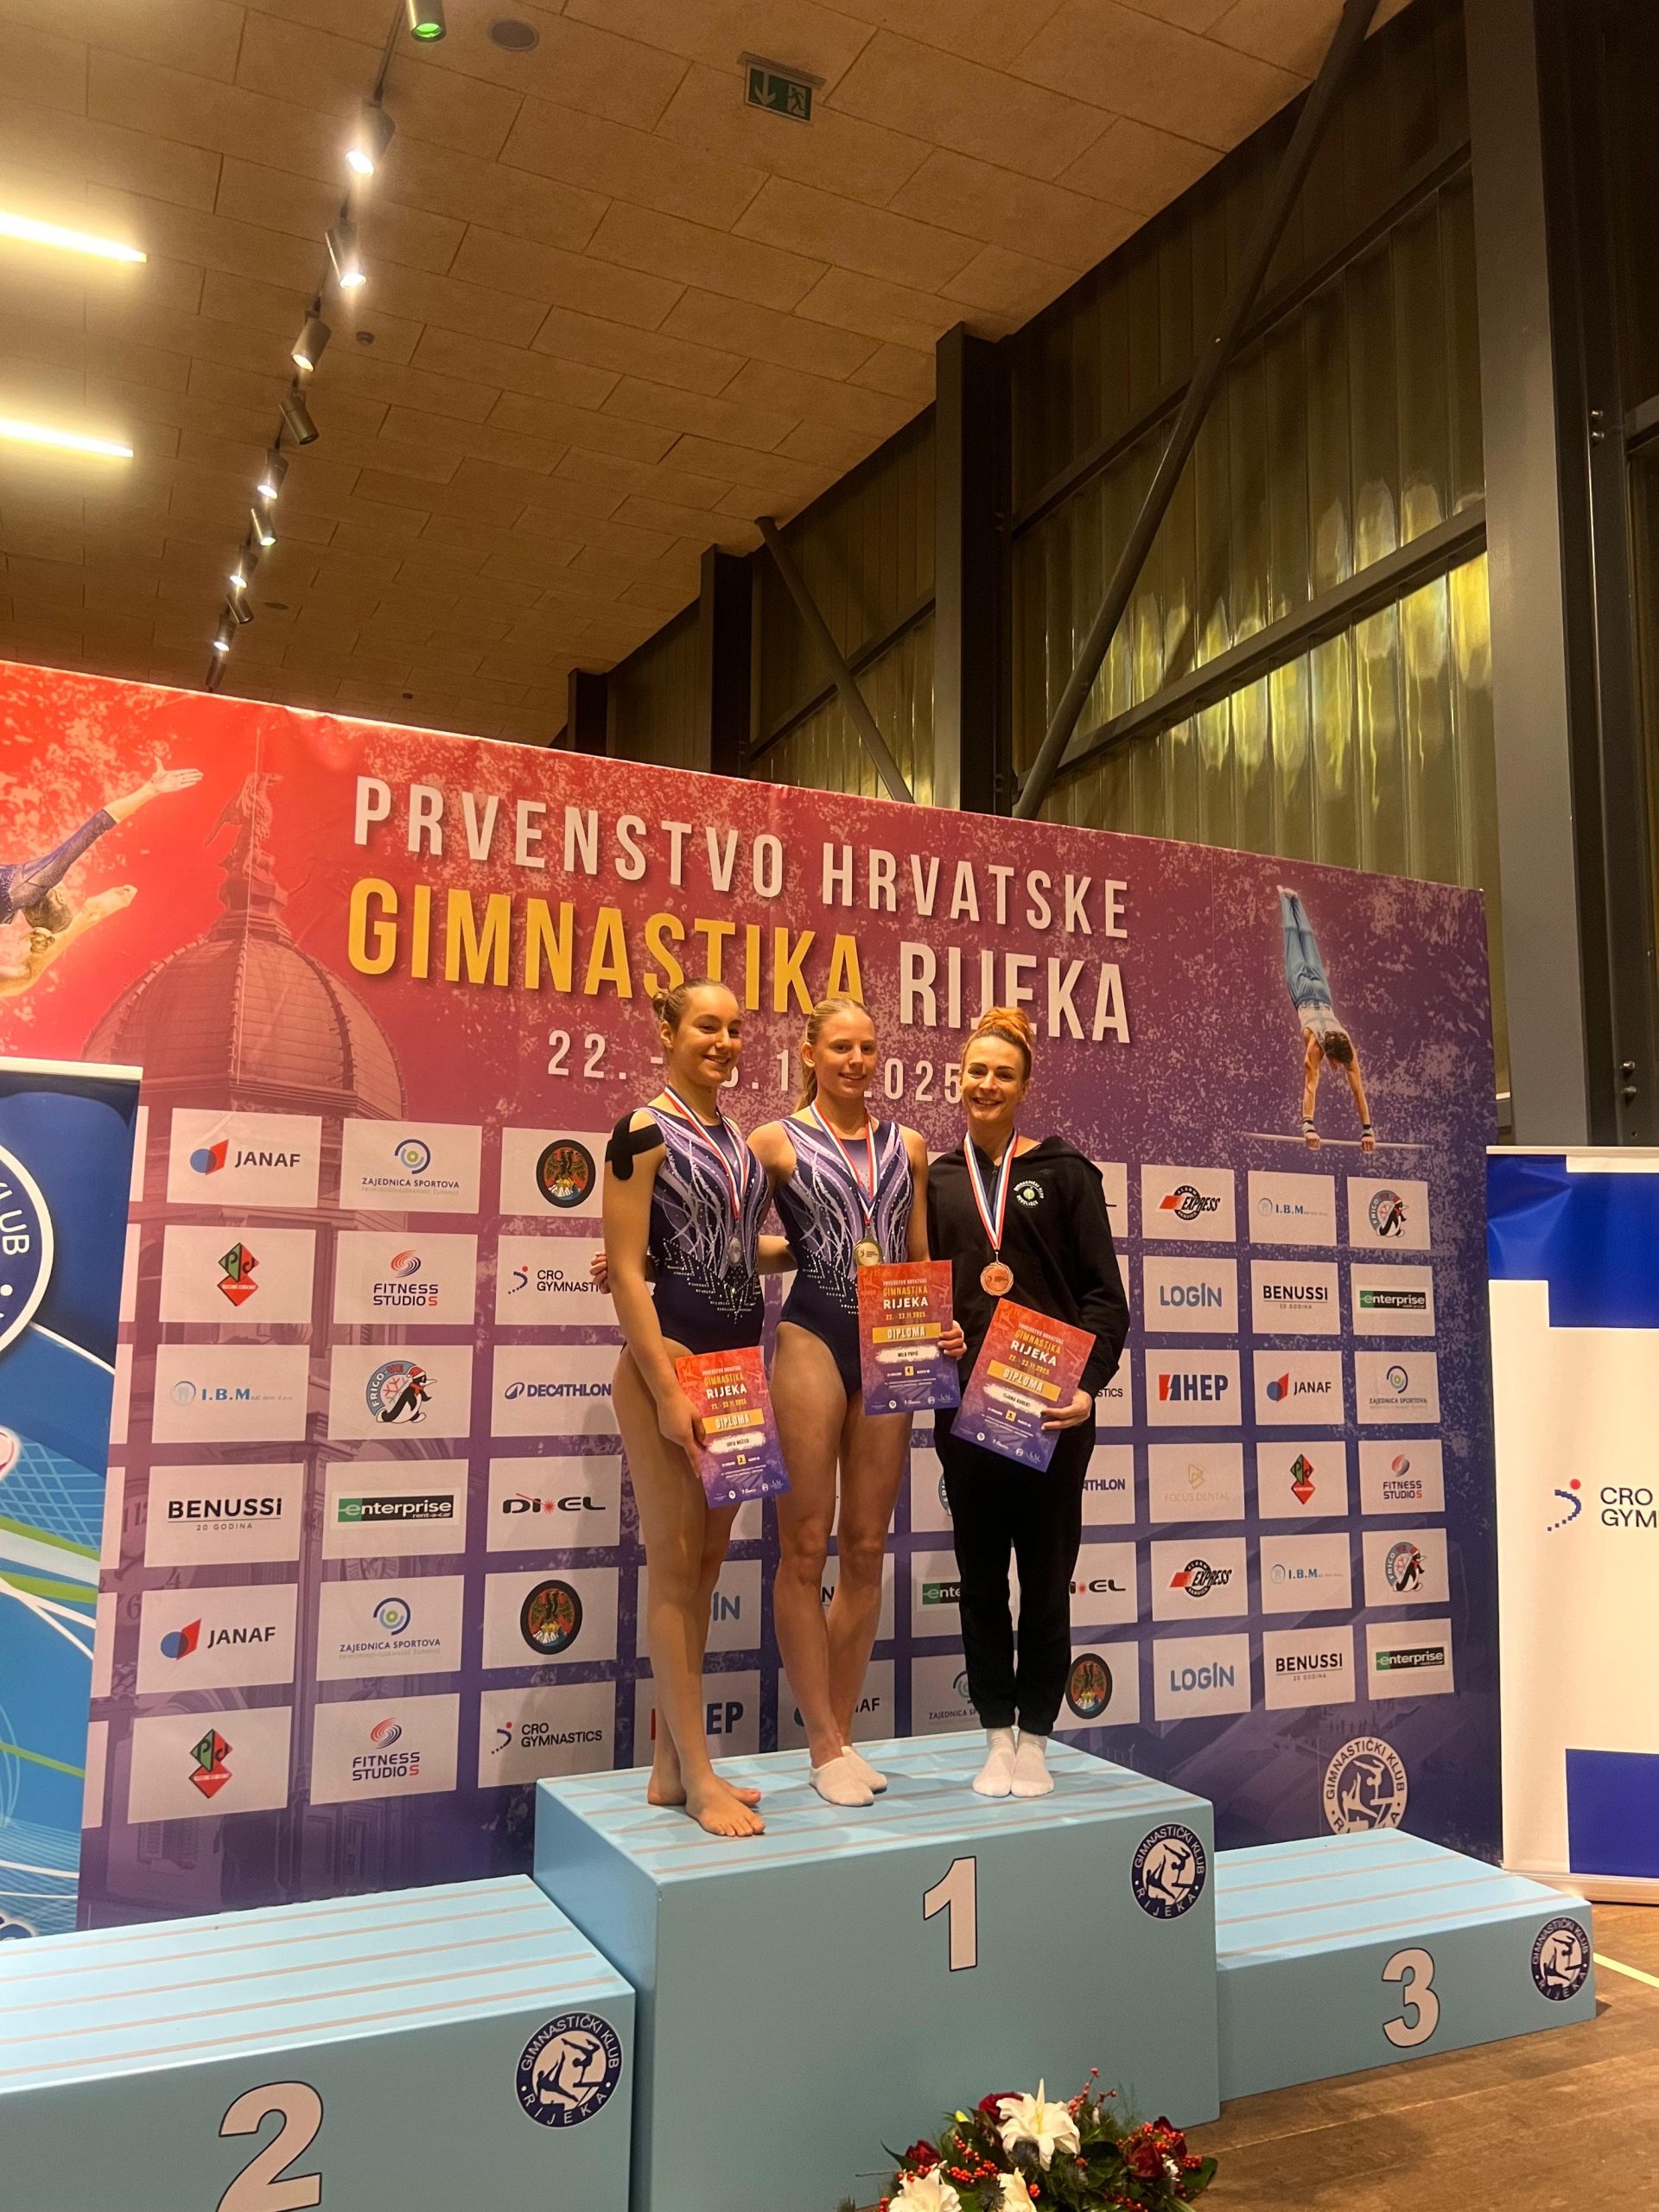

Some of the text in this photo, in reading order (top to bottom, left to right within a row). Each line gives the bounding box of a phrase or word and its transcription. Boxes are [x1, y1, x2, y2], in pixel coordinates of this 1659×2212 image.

[354, 775, 1128, 938] PRVENSTVO HRVATSKE
[347, 878, 1130, 1043] GIMNASTIKA RIJEKA
[235, 1151, 300, 1168] JANAF
[362, 1178, 460, 1188] ZAJEDNICA SPORTOVA
[1181, 1196, 1221, 1211] EXPRESS
[537, 1270, 563, 1280] CRO
[373, 1283, 438, 1294] FITNESS
[537, 1281, 601, 1292] GYMNASTI
[883, 1285, 928, 1297] GIMNASTIKA
[883, 1297, 929, 1309] RIJEKA
[1363, 1294, 1425, 1306] enterprise
[887, 1326, 926, 1339] DIPLOMA
[1015, 1329, 1062, 1355] GIMNASTIKA
[1010, 1340, 1057, 1366] RIJEKA
[704, 1372, 744, 1387] GIMNASTIKA
[1002, 1369, 1044, 1394] DIPLOMA
[1183, 1375, 1228, 1401] HEP
[1294, 1381, 1332, 1395] JANAF
[527, 1383, 612, 1397] DECATHLON
[706, 1383, 747, 1400] RIJEKA
[715, 1413, 750, 1429] DIPLOMA
[1383, 1480, 1421, 1490] FITNESS
[1600, 1487, 1653, 1505] CRO
[344, 1499, 452, 1518] enterprise
[1601, 1509, 1659, 1528] GYM
[1192, 1569, 1232, 1586] EXPRESS
[207, 1626, 276, 1649] JANAF
[340, 1638, 441, 1653] ZAJEDNICA SPORTOVA
[1381, 1650, 1444, 1667] enterprise
[707, 1701, 744, 1735] EP
[929, 1709, 967, 1719] ZAJEDNICA
[521, 1723, 549, 1735] CRO
[521, 1730, 602, 1748] GYMNASTICS
[353, 1752, 420, 1768] FITNESS
[1325, 1738, 1405, 1799] GIMNASTIČKI KLUB
[1134, 1826, 1205, 1873] GIMNASTIČKI KLUB
[1136, 1887, 1196, 1917] RIJEKA
[924, 1855, 977, 1972] 1
[1382, 1947, 1440, 2048] 3
[521, 2015, 620, 2071] GIMNASTIČKI KLUB
[523, 2093, 607, 2126] RIJEKA
[216, 2080, 324, 2212] 2
